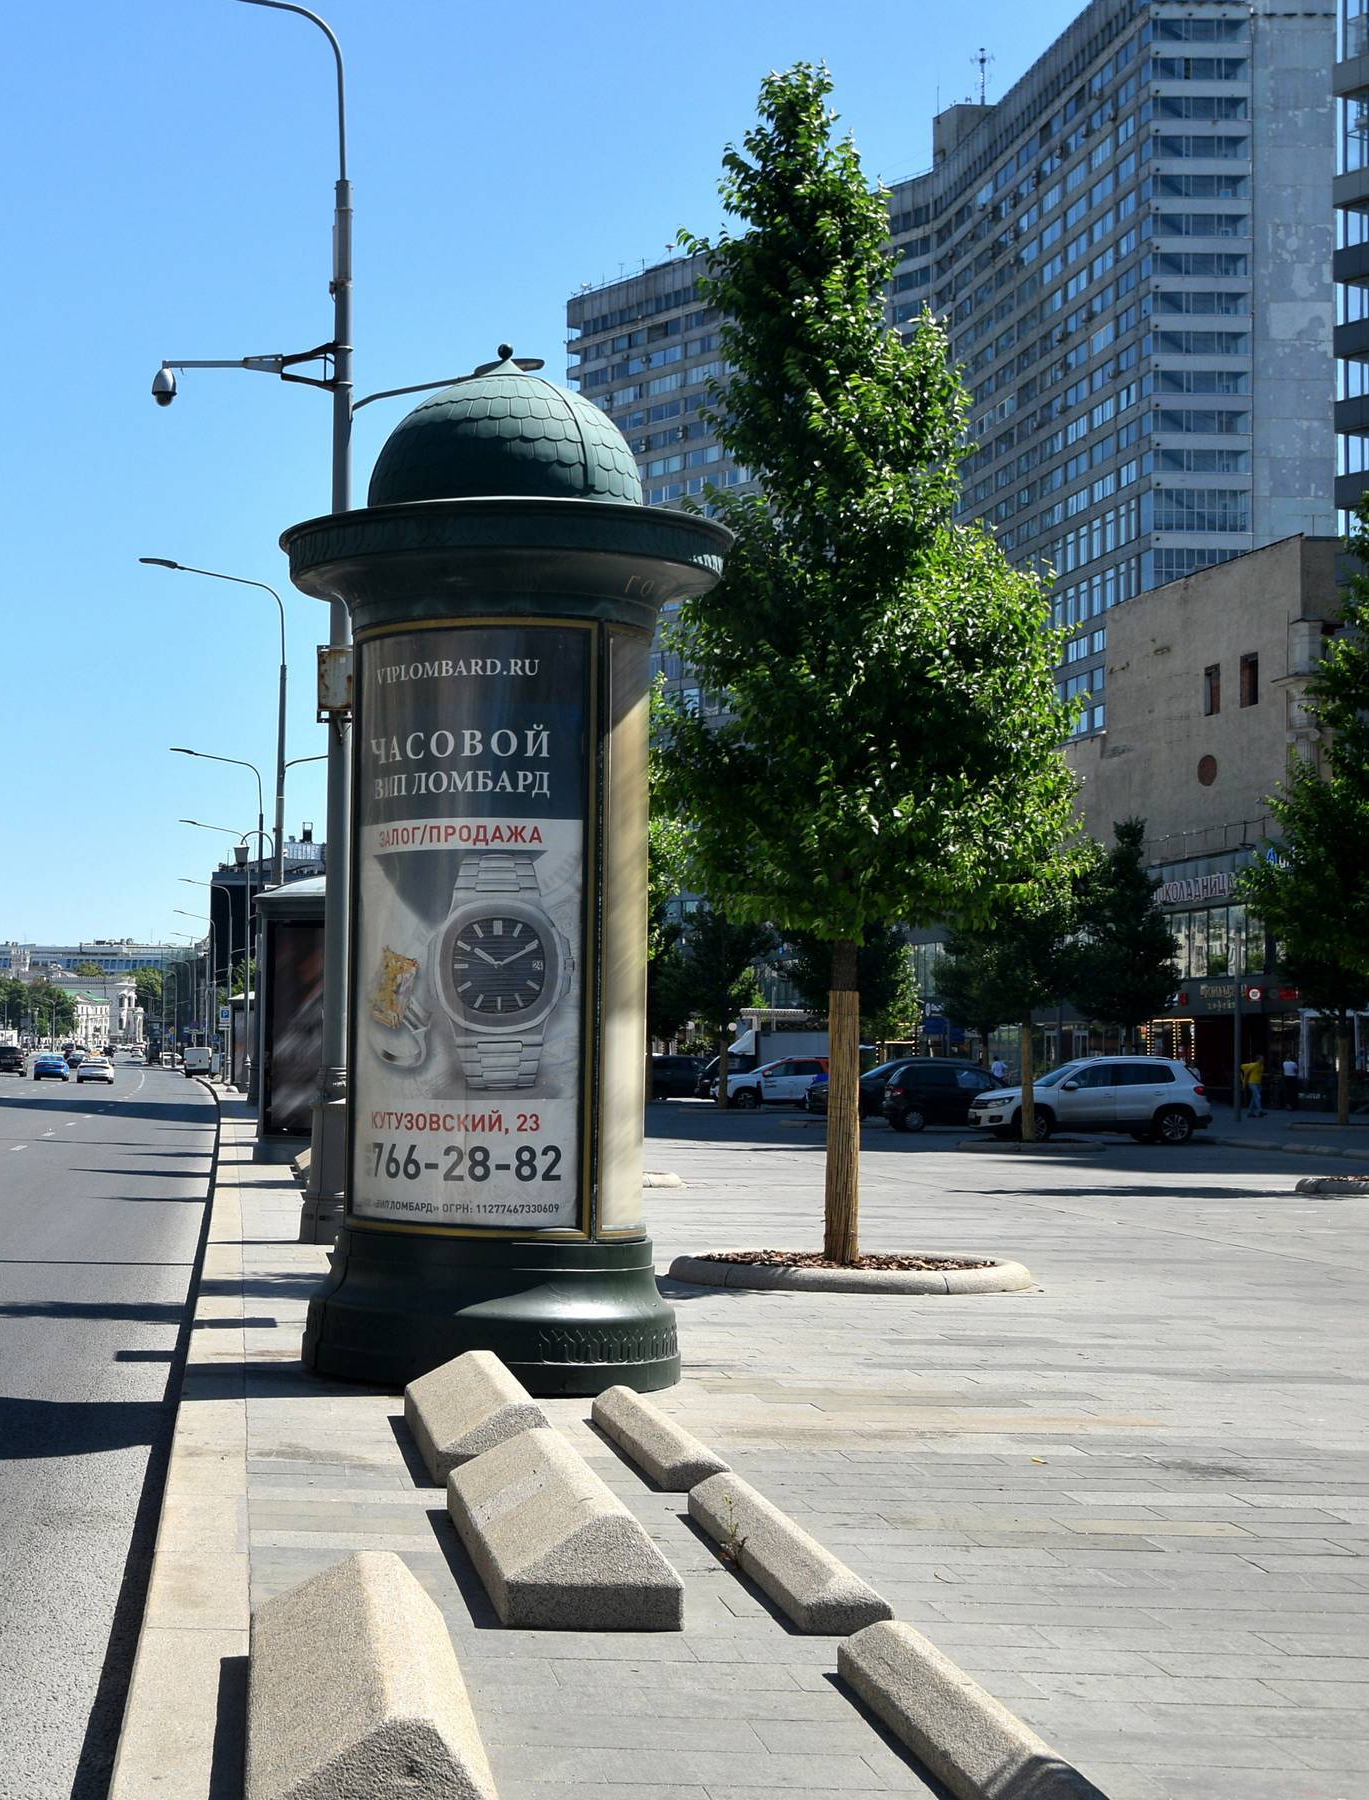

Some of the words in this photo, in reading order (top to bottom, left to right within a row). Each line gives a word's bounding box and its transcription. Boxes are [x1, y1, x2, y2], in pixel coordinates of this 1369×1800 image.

[376, 658, 540, 685] VIPLOMBARD.RU
[370, 723, 551, 764] ЧАСОВОЙ
[373, 774, 408, 800] ВИП
[411, 770, 551, 799] ЛОМБАРД
[378, 824, 543, 848] ЗАЛОГ/ПРОДАЖА
[371, 1110, 509, 1136] КУТУЗОВСКИЙ,
[516, 1113, 540, 1132] 23
[372, 1142, 562, 1182] 766-28-82
[442, 1204, 473, 1214] ОГРН:
